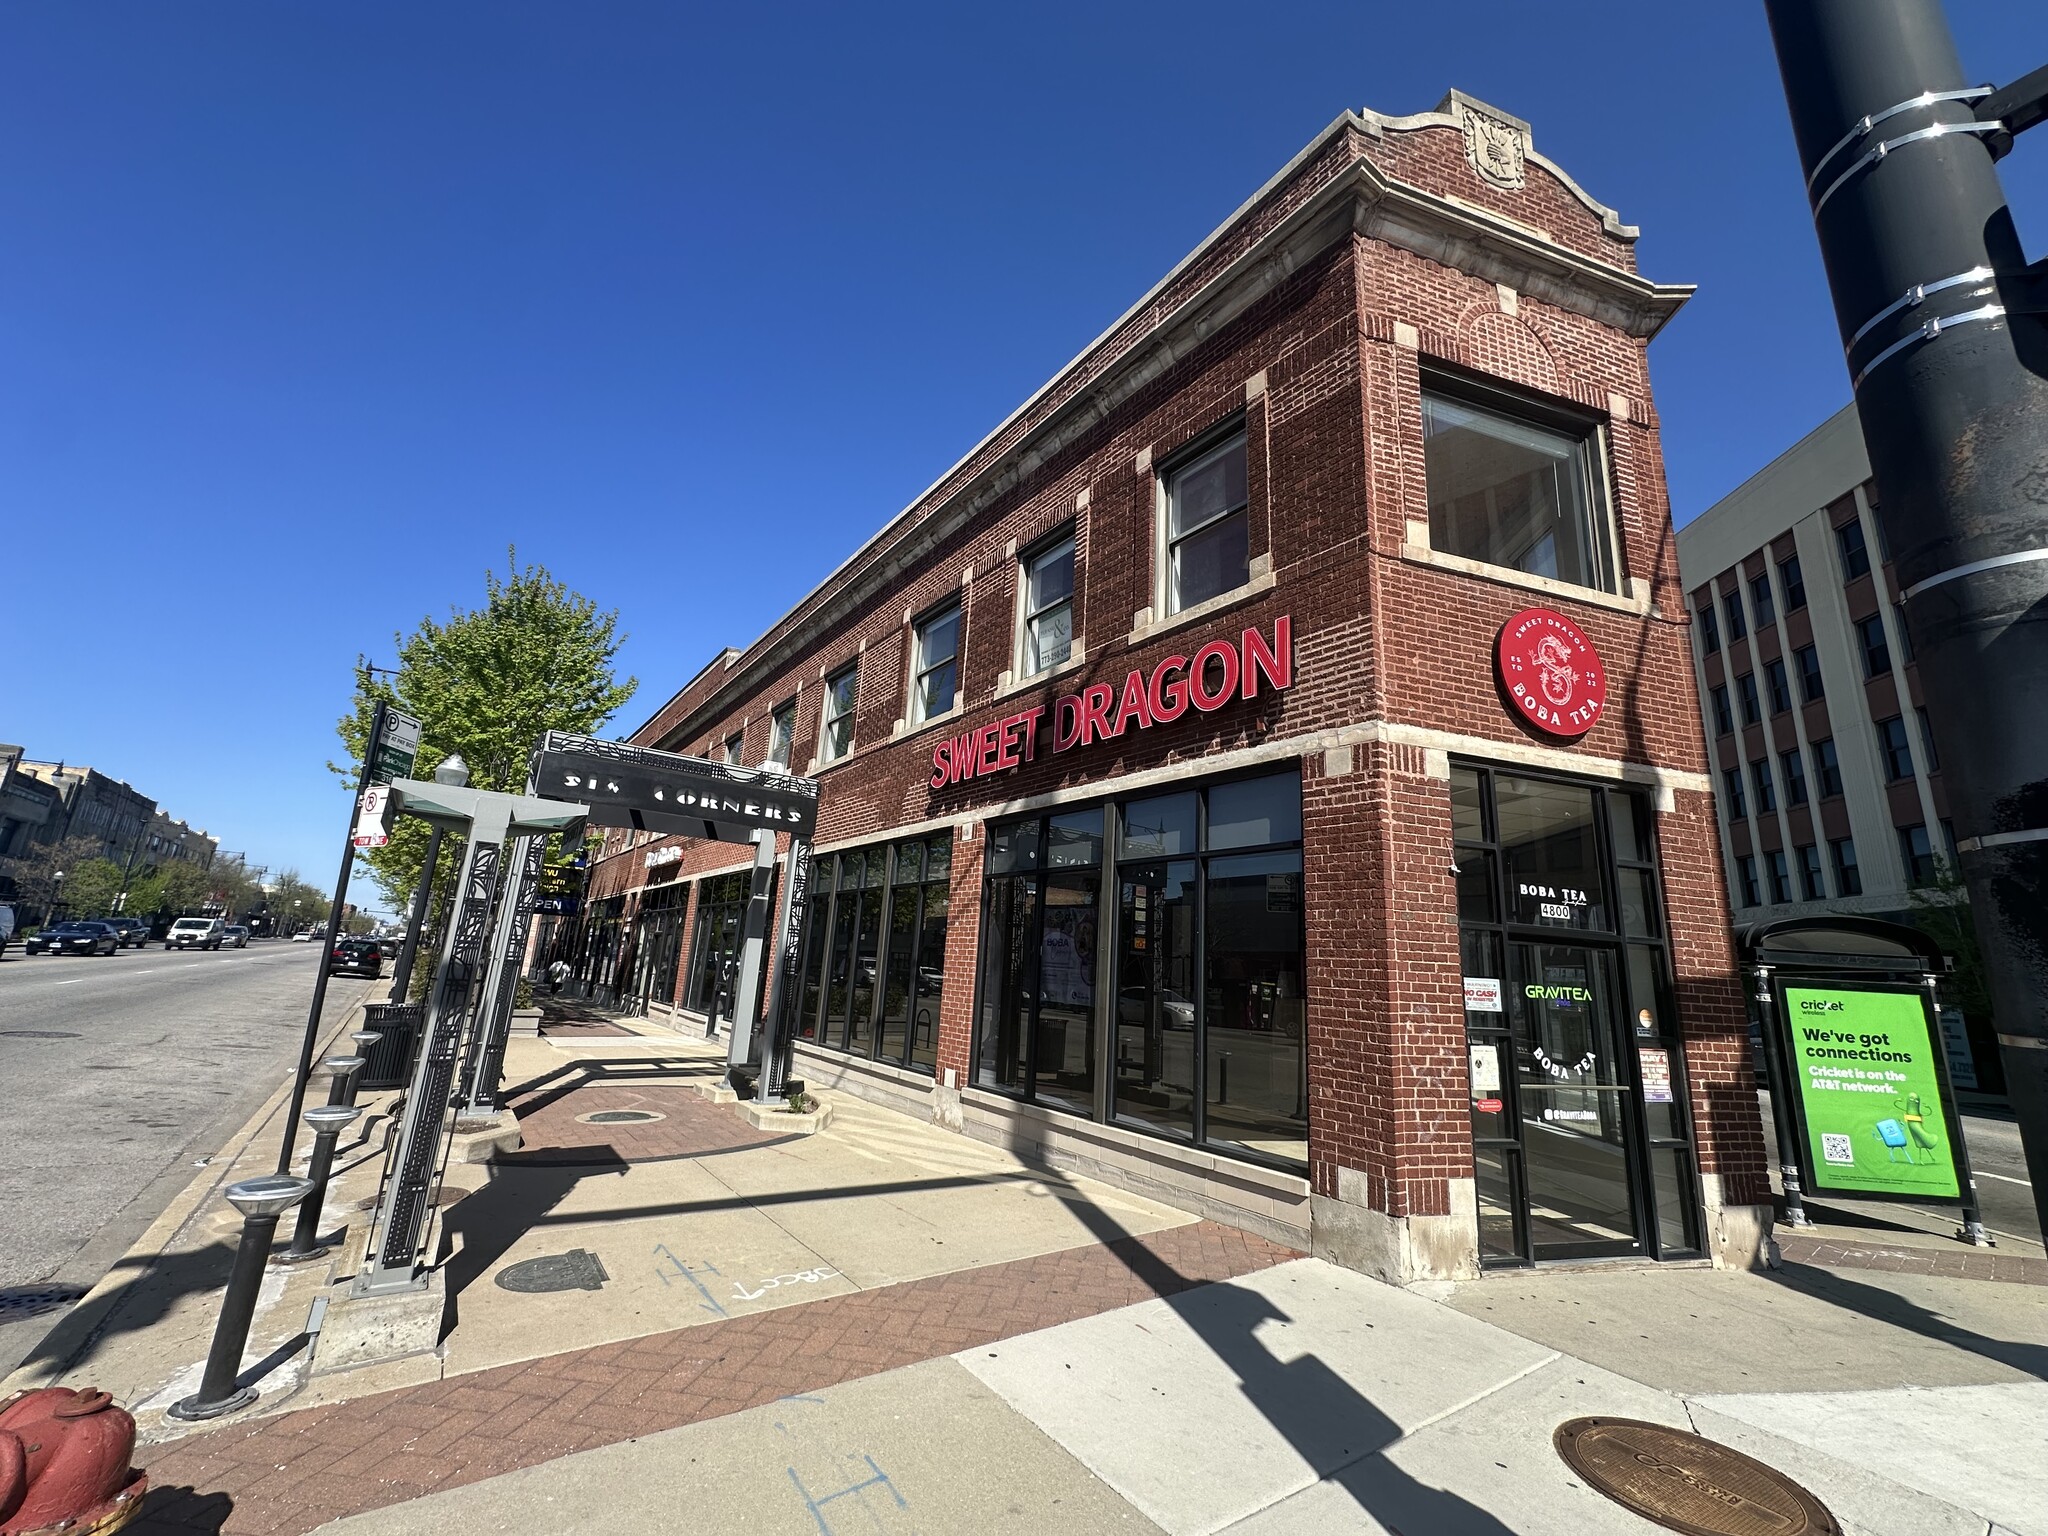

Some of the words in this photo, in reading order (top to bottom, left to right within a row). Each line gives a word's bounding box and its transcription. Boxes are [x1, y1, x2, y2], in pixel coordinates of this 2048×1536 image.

[1515, 617, 1543, 639] SWEET
[1547, 618, 1587, 653] DRAGON
[930, 704, 1046, 789] SWEET
[1053, 614, 1291, 753] DRAGON
[1513, 682, 1561, 726] BOBA
[1569, 698, 1599, 725] TEA
[563, 768, 624, 794] SIX
[653, 783, 803, 823] CORNERS
[1519, 883, 1556, 898] BOBA
[1562, 888, 1587, 901] TEA
[535, 899, 562, 910] PEN
[1542, 904, 1569, 918] 4800
[1475, 990, 1497, 998] CASH
[1525, 984, 1592, 1002] GRAVITEA
[1801, 1000, 1845, 1011] cricket
[1802, 1028, 1855, 1043] We've
[1859, 1033, 1890, 1048] got
[1533, 1046, 1570, 1080] BOBA
[1574, 1051, 1597, 1076] TEA
[1805, 1046, 1912, 1063] connections
[1808, 1065, 1854, 1079] Cricket
[1854, 1067, 1865, 1079] is
[1866, 1070, 1883, 1080] on
[1884, 1070, 1907, 1082] the
[1811, 1078, 1840, 1090] AT&T
[1841, 1081, 1899, 1095] network.
